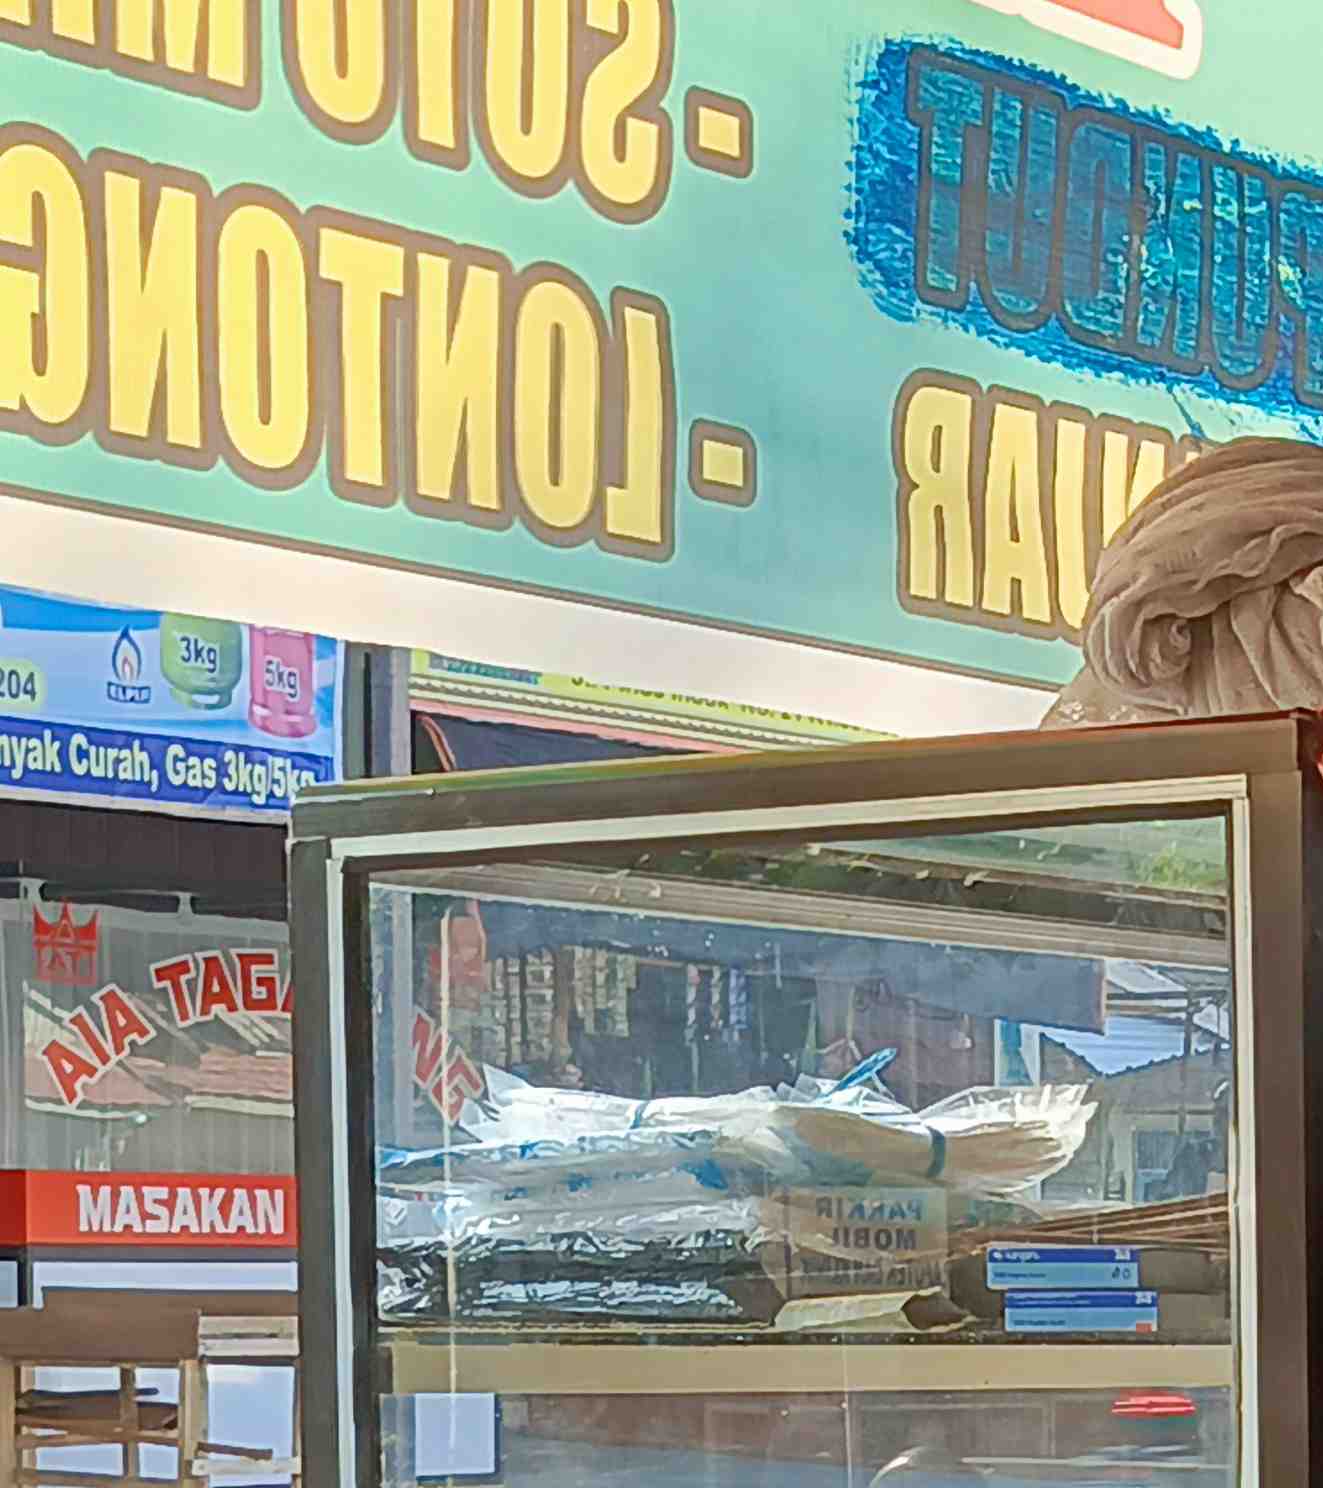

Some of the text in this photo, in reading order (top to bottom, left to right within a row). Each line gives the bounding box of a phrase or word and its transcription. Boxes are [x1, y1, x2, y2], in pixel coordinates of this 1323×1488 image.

[180, 636, 217, 673] 3kg
[264, 660, 297, 699] 5kg
[69, 733, 158, 793] Curah,
[166, 745, 217, 790] Gas
[42, 983, 157, 1110] AIA
[76, 1184, 284, 1234] MASAKAN
